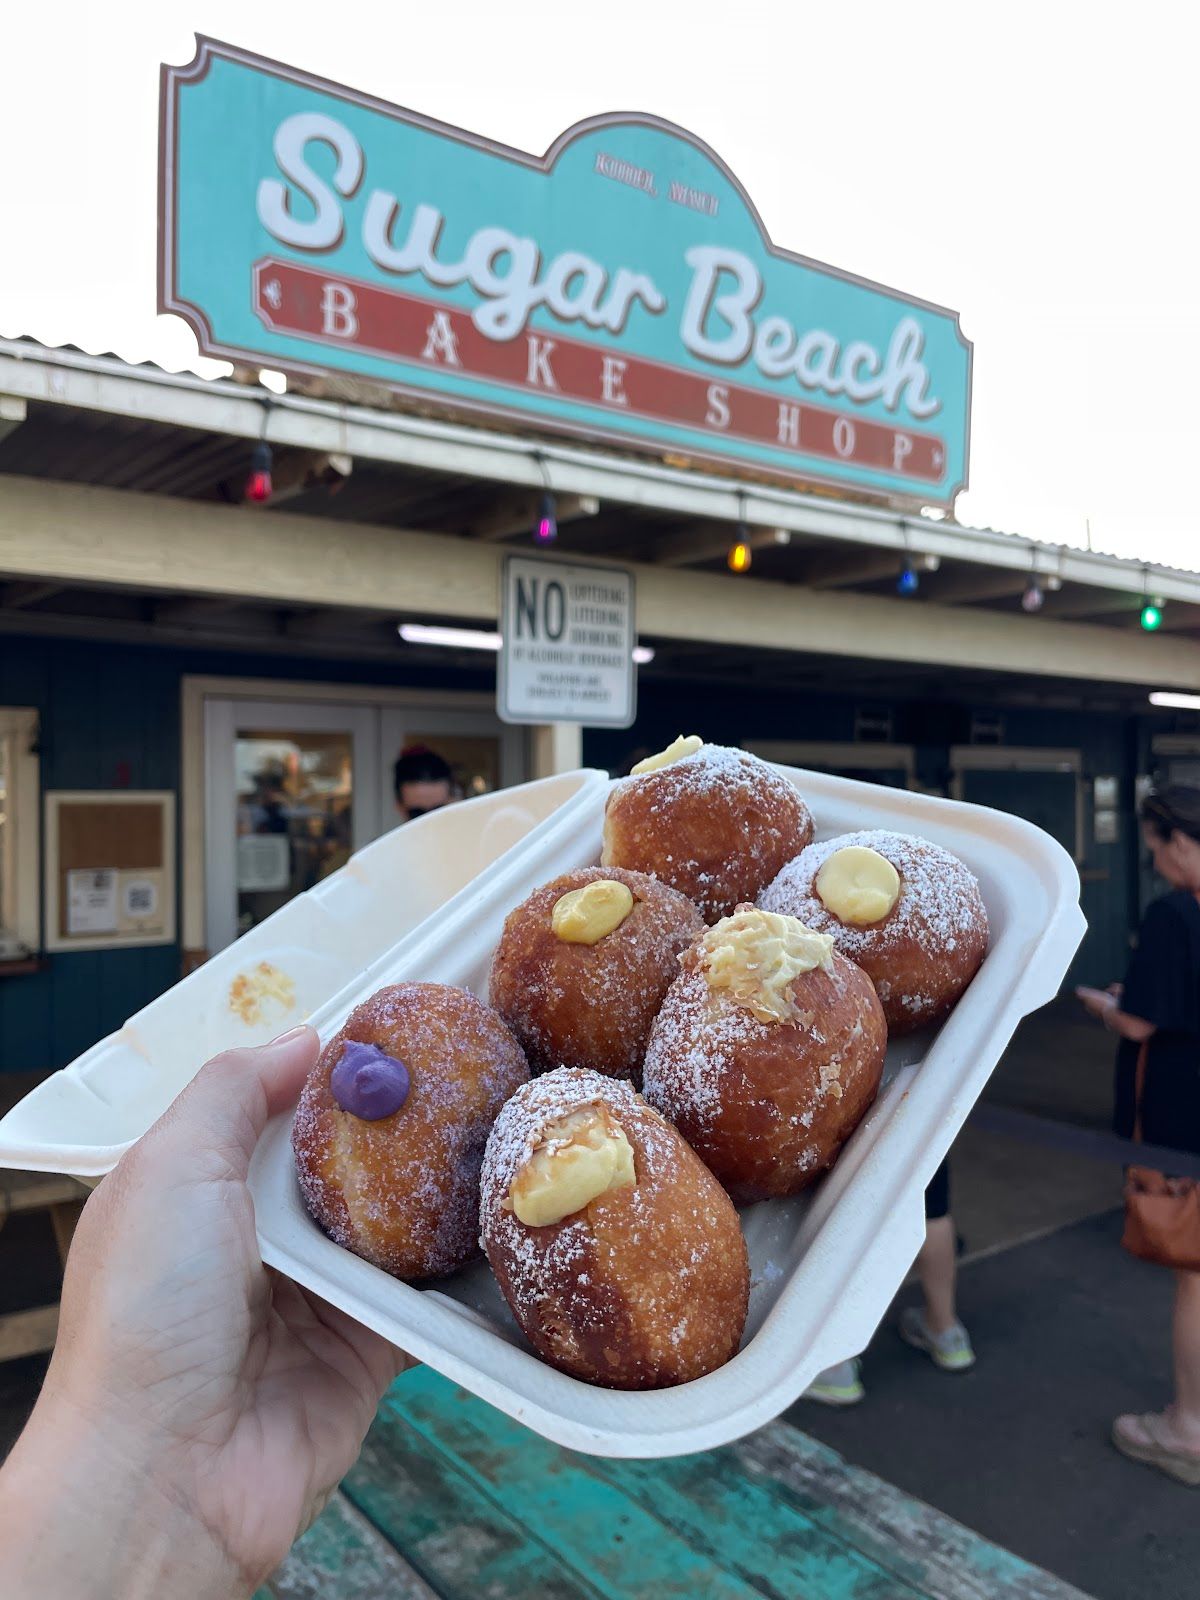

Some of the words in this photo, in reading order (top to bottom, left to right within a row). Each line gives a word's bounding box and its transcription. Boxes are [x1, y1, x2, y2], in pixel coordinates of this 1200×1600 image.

[256, 112, 664, 341] Sugar
[680, 246, 938, 416] Beach
[320, 282, 628, 407] BAKE
[704, 385, 913, 470] SHOP
[515, 577, 565, 642] NO
